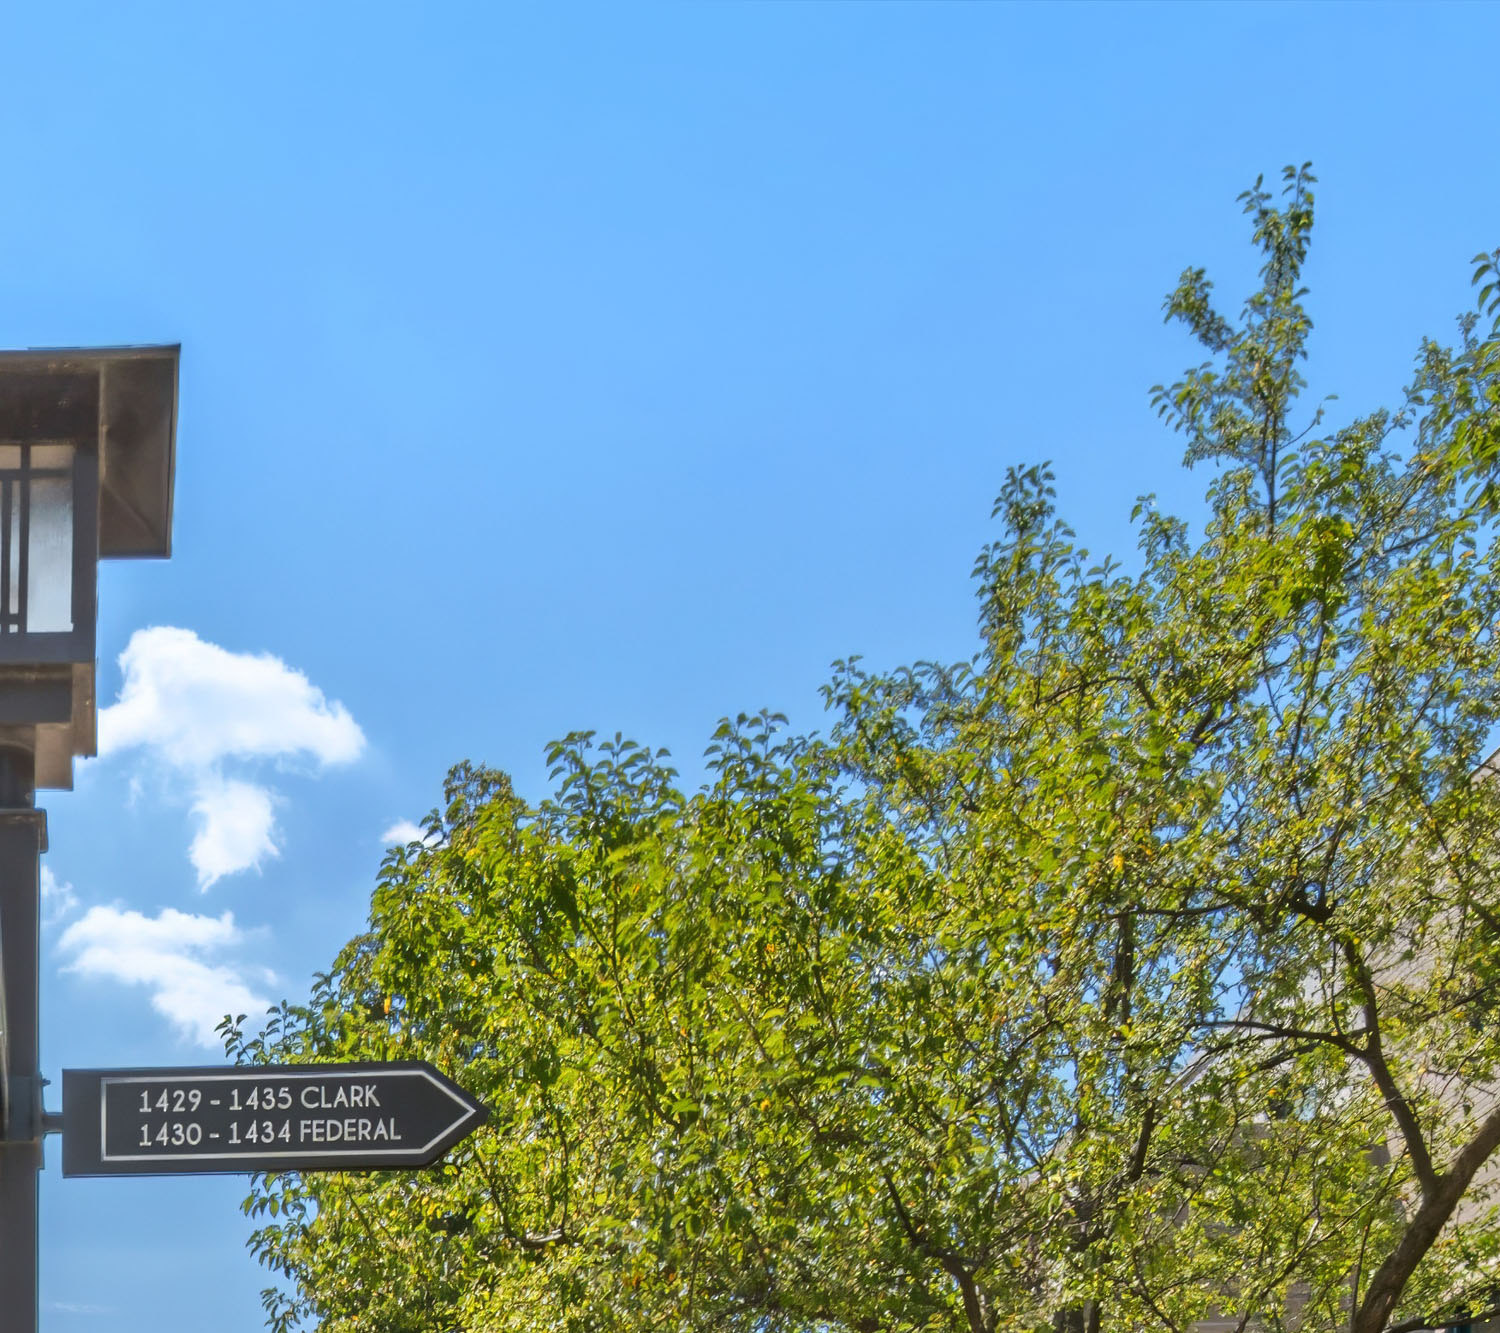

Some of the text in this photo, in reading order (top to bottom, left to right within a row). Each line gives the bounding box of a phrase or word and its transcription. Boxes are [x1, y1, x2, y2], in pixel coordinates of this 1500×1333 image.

[139, 1088, 202, 1112] 1429
[229, 1086, 293, 1111] 1435
[300, 1084, 381, 1109] CLARK
[139, 1122, 202, 1146] 1430
[228, 1120, 291, 1144] 1434
[300, 1118, 402, 1142] FEDERAL
